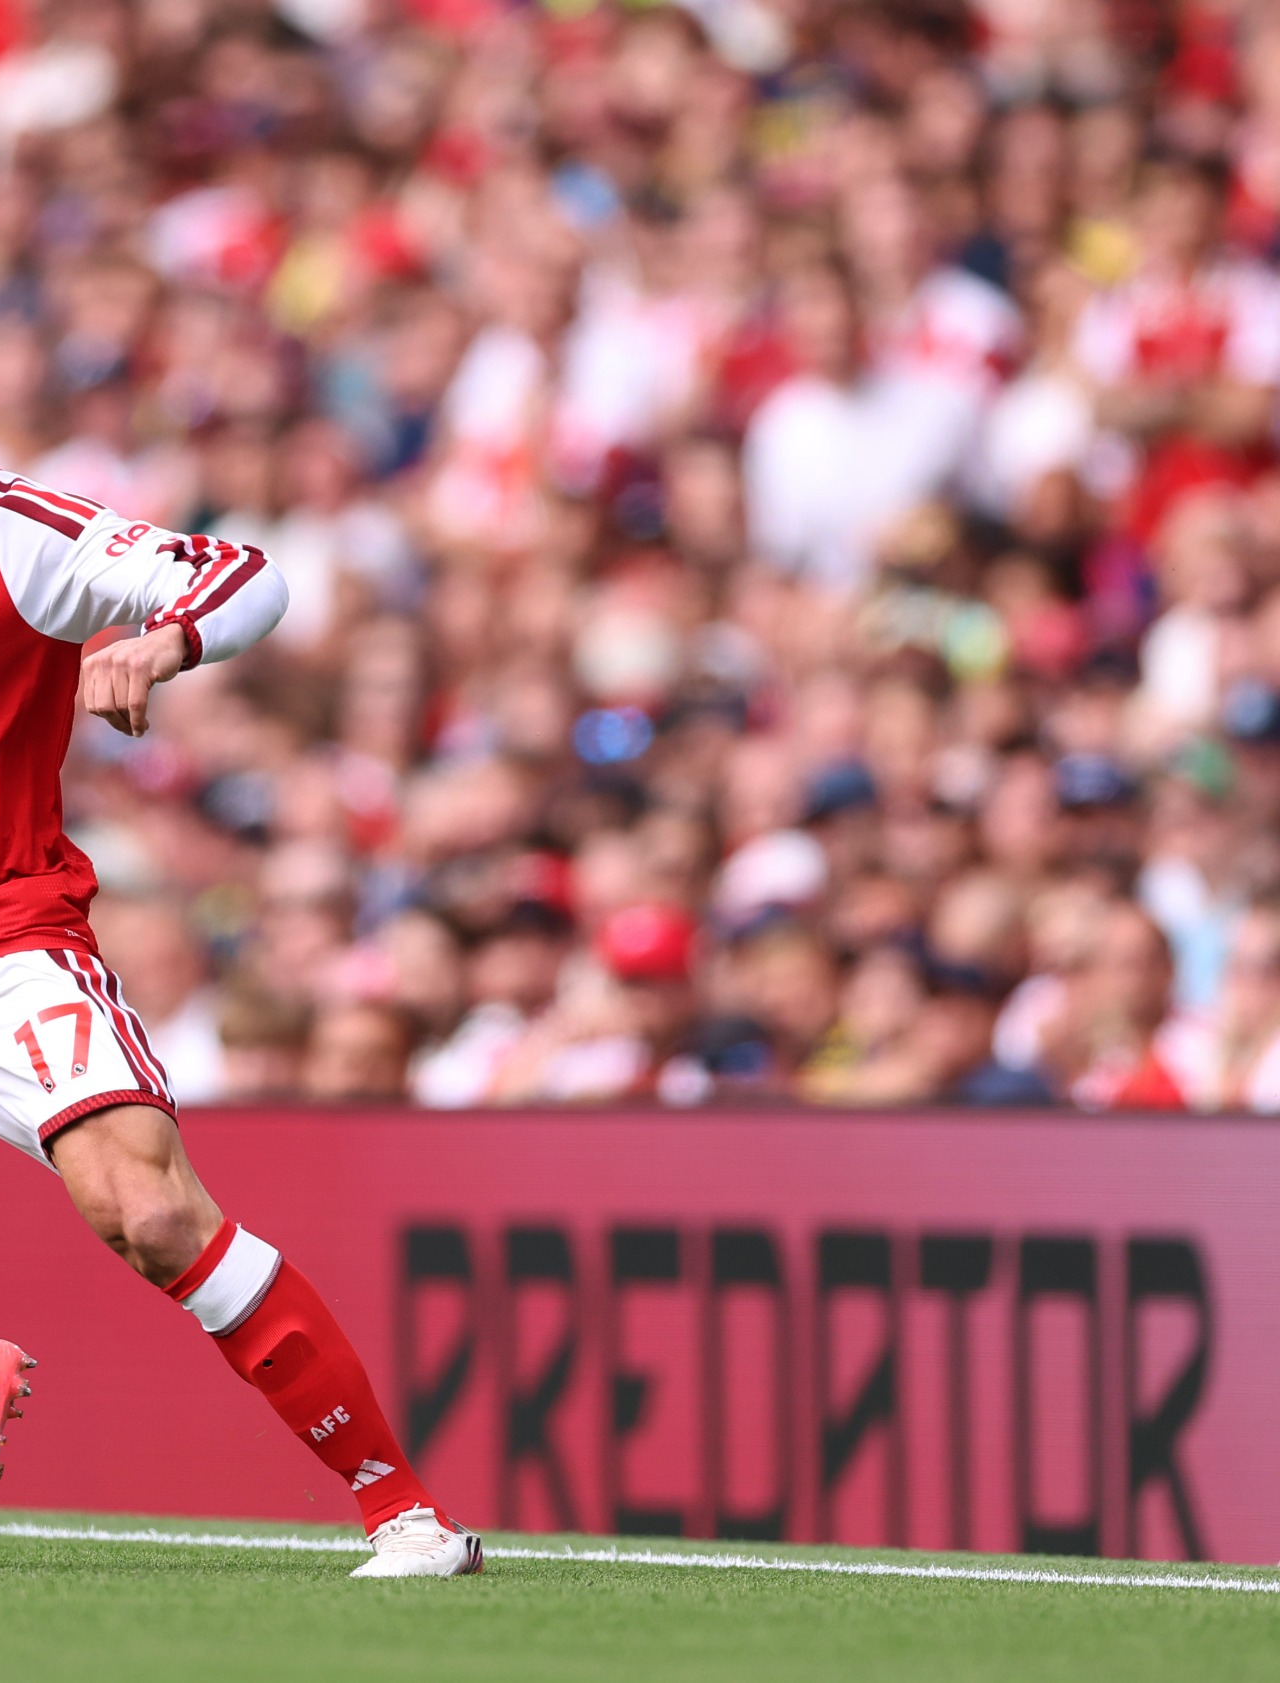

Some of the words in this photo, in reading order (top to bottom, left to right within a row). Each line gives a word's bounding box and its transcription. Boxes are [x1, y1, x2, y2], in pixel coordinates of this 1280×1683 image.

[13, 999, 93, 1094] 17
[310, 1405, 352, 1442] AFC
[400, 1224, 1214, 1562] PREDATOR
